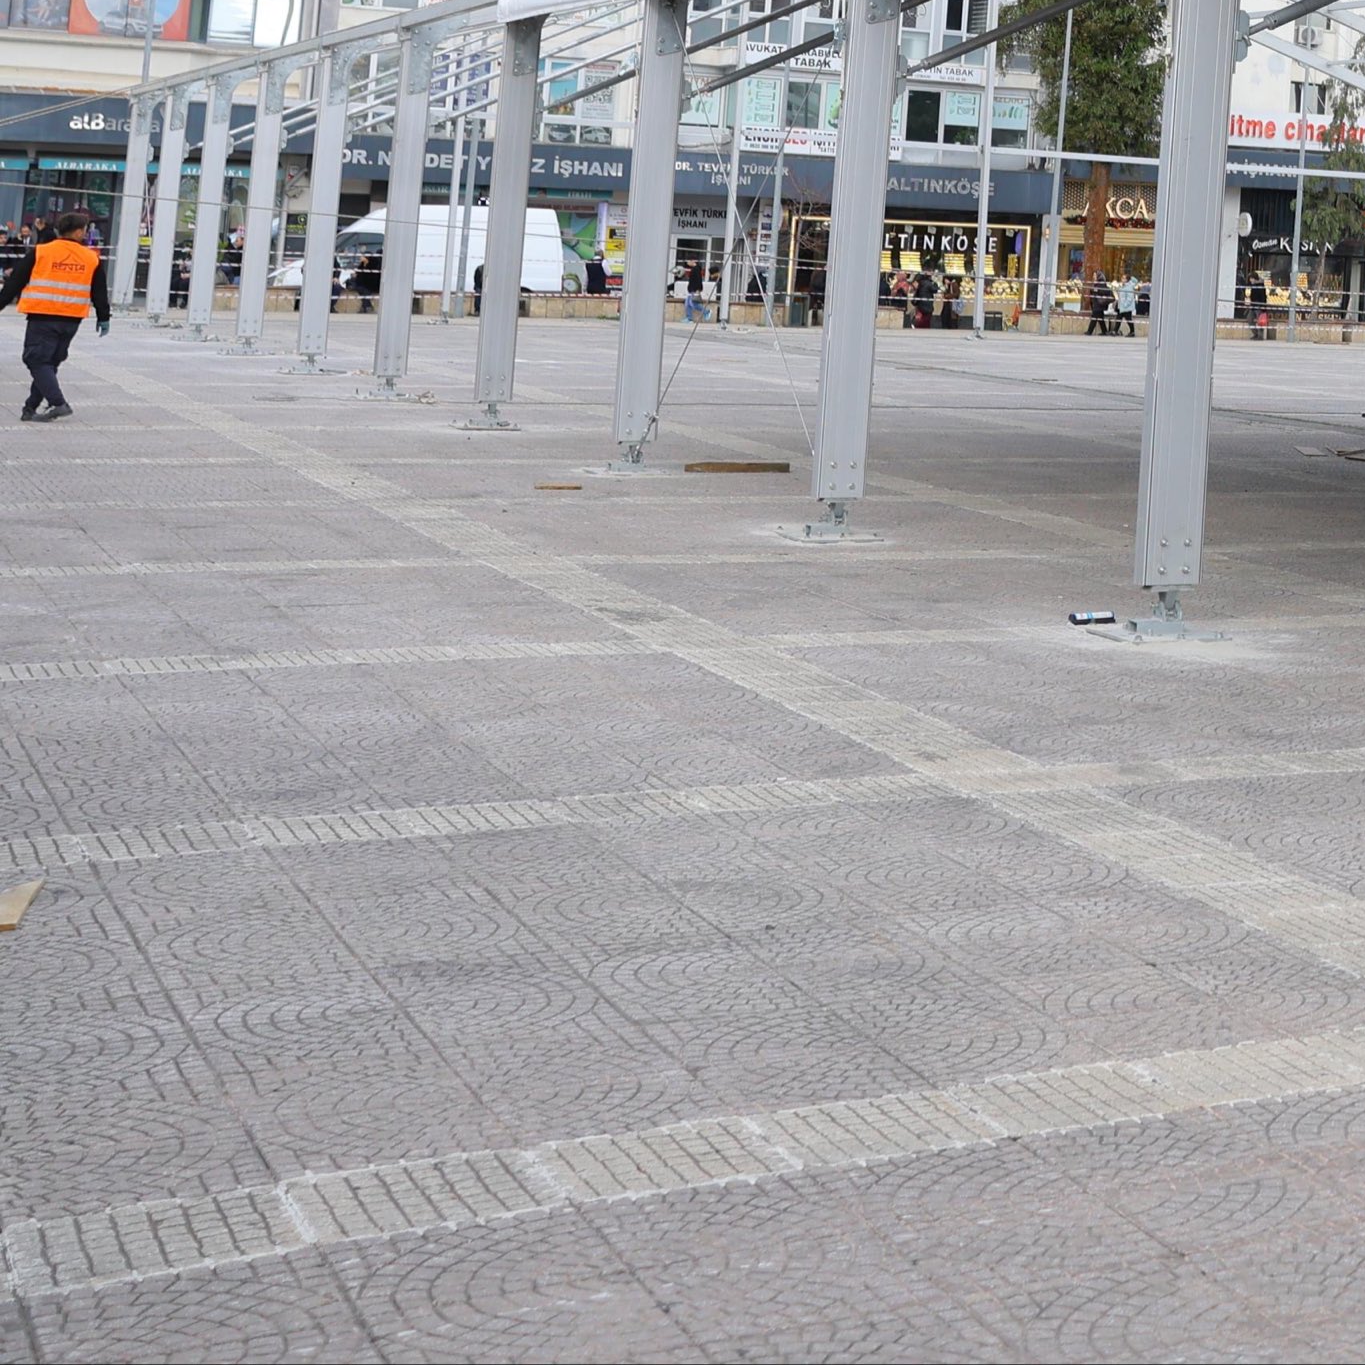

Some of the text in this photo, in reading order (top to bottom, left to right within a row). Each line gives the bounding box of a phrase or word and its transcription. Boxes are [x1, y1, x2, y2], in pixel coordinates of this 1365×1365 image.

[794, 57, 831, 68] TABAK
[946, 67, 973, 77] TABAK
[1229, 114, 1276, 139] itme
[554, 155, 623, 179] İŞHANI
[675, 161, 693, 171] DR.
[678, 219, 707, 229] İŞHANI
[1252, 238, 1277, 250] Osman
